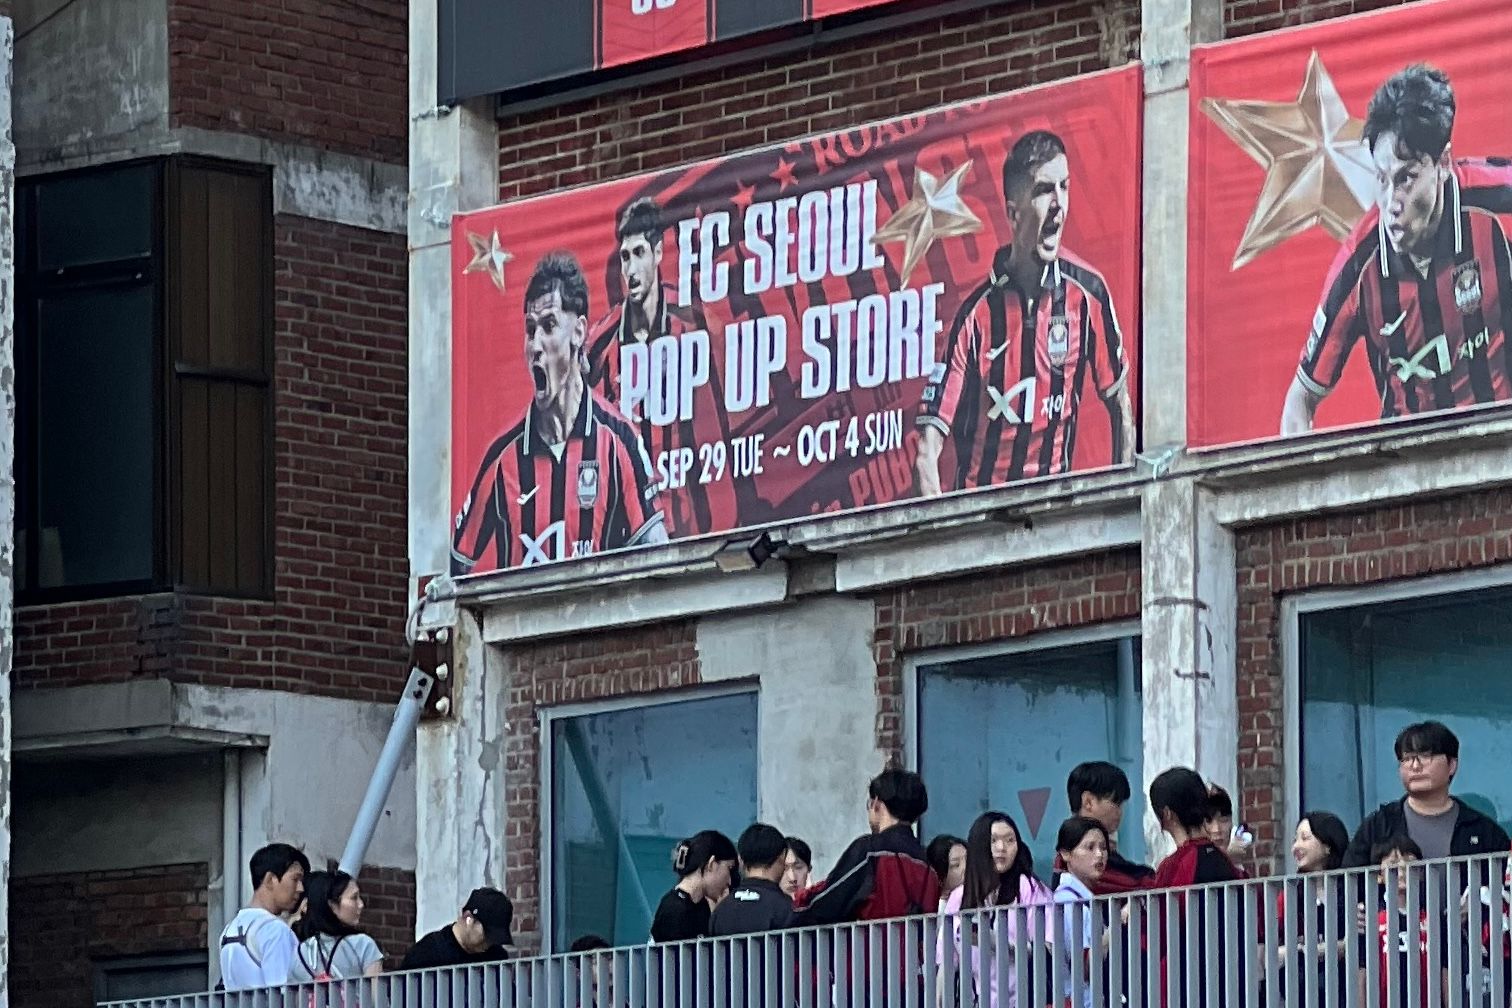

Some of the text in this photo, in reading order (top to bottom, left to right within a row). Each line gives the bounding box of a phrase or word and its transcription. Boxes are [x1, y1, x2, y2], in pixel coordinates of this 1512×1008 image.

[677, 211, 730, 308] FC
[743, 179, 885, 295] SEOUL
[620, 282, 945, 427] POP UP STORE
[656, 447, 694, 491] SEP
[699, 440, 727, 485] 29
[731, 433, 765, 478] TUE
[798, 420, 841, 467] OCT
[844, 415, 860, 458] 4
[864, 408, 903, 455] SUN
